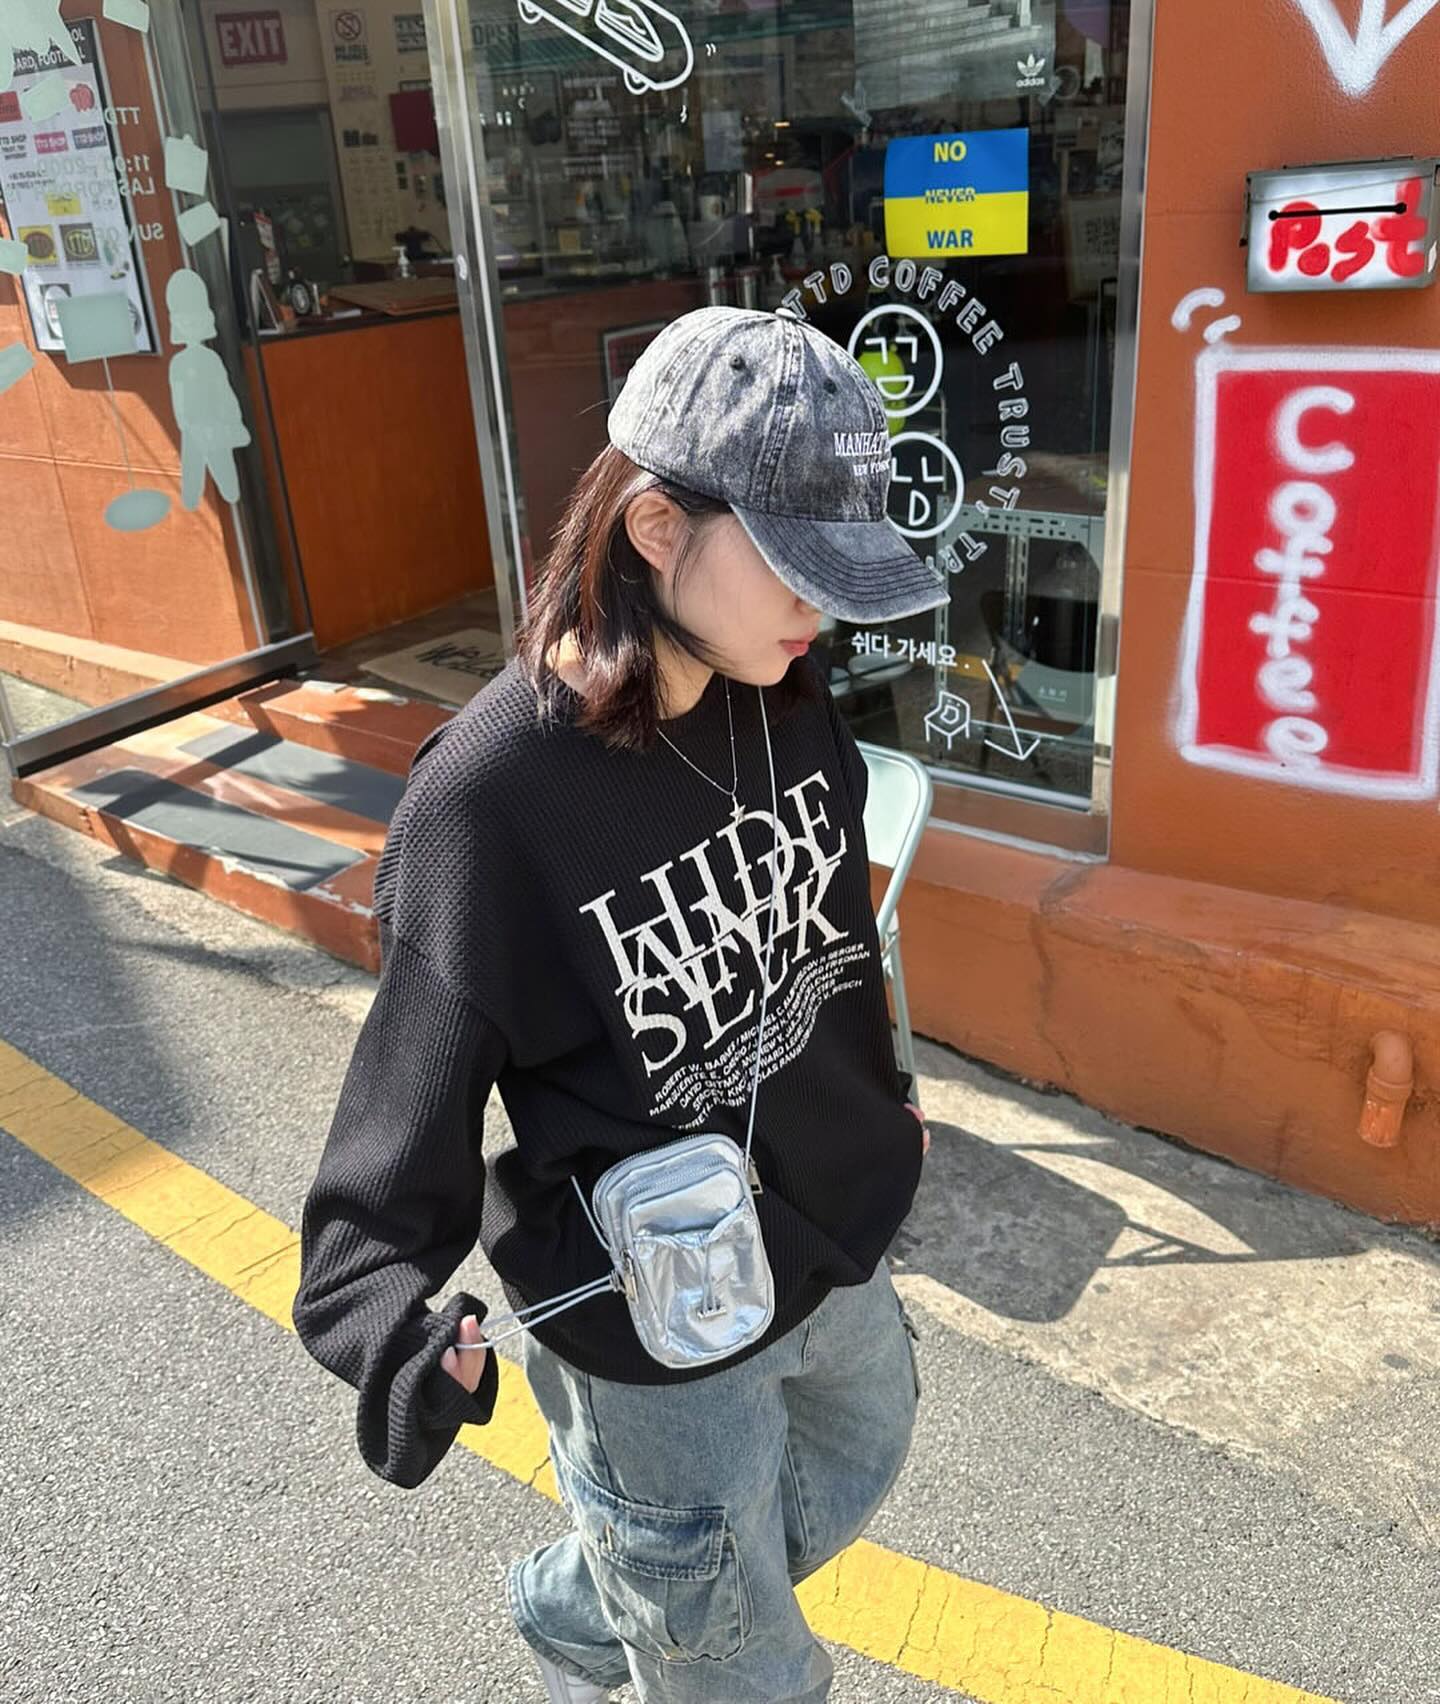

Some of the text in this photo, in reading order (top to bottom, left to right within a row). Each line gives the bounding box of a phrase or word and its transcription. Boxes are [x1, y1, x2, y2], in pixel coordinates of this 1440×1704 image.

[219, 18, 283, 58] EXIT
[1016, 77, 1045, 87] adidas
[933, 140, 968, 163] NO
[924, 186, 977, 205] NEVER
[926, 229, 974, 250] WAR
[1267, 176, 1427, 283] Post
[782, 262, 853, 320] TTD
[868, 255, 1004, 356] COFFEE
[1249, 384, 1356, 772] Coffee
[851, 631, 891, 659] 쉬다
[578, 769, 848, 996] HIDE
[622, 859, 849, 1078] SEEK
[752, 1021, 780, 1049] JSON
[654, 1065, 688, 1103] ROBERT
[679, 1081, 702, 1108] DAVID
[693, 1088, 724, 1112] STACEY
